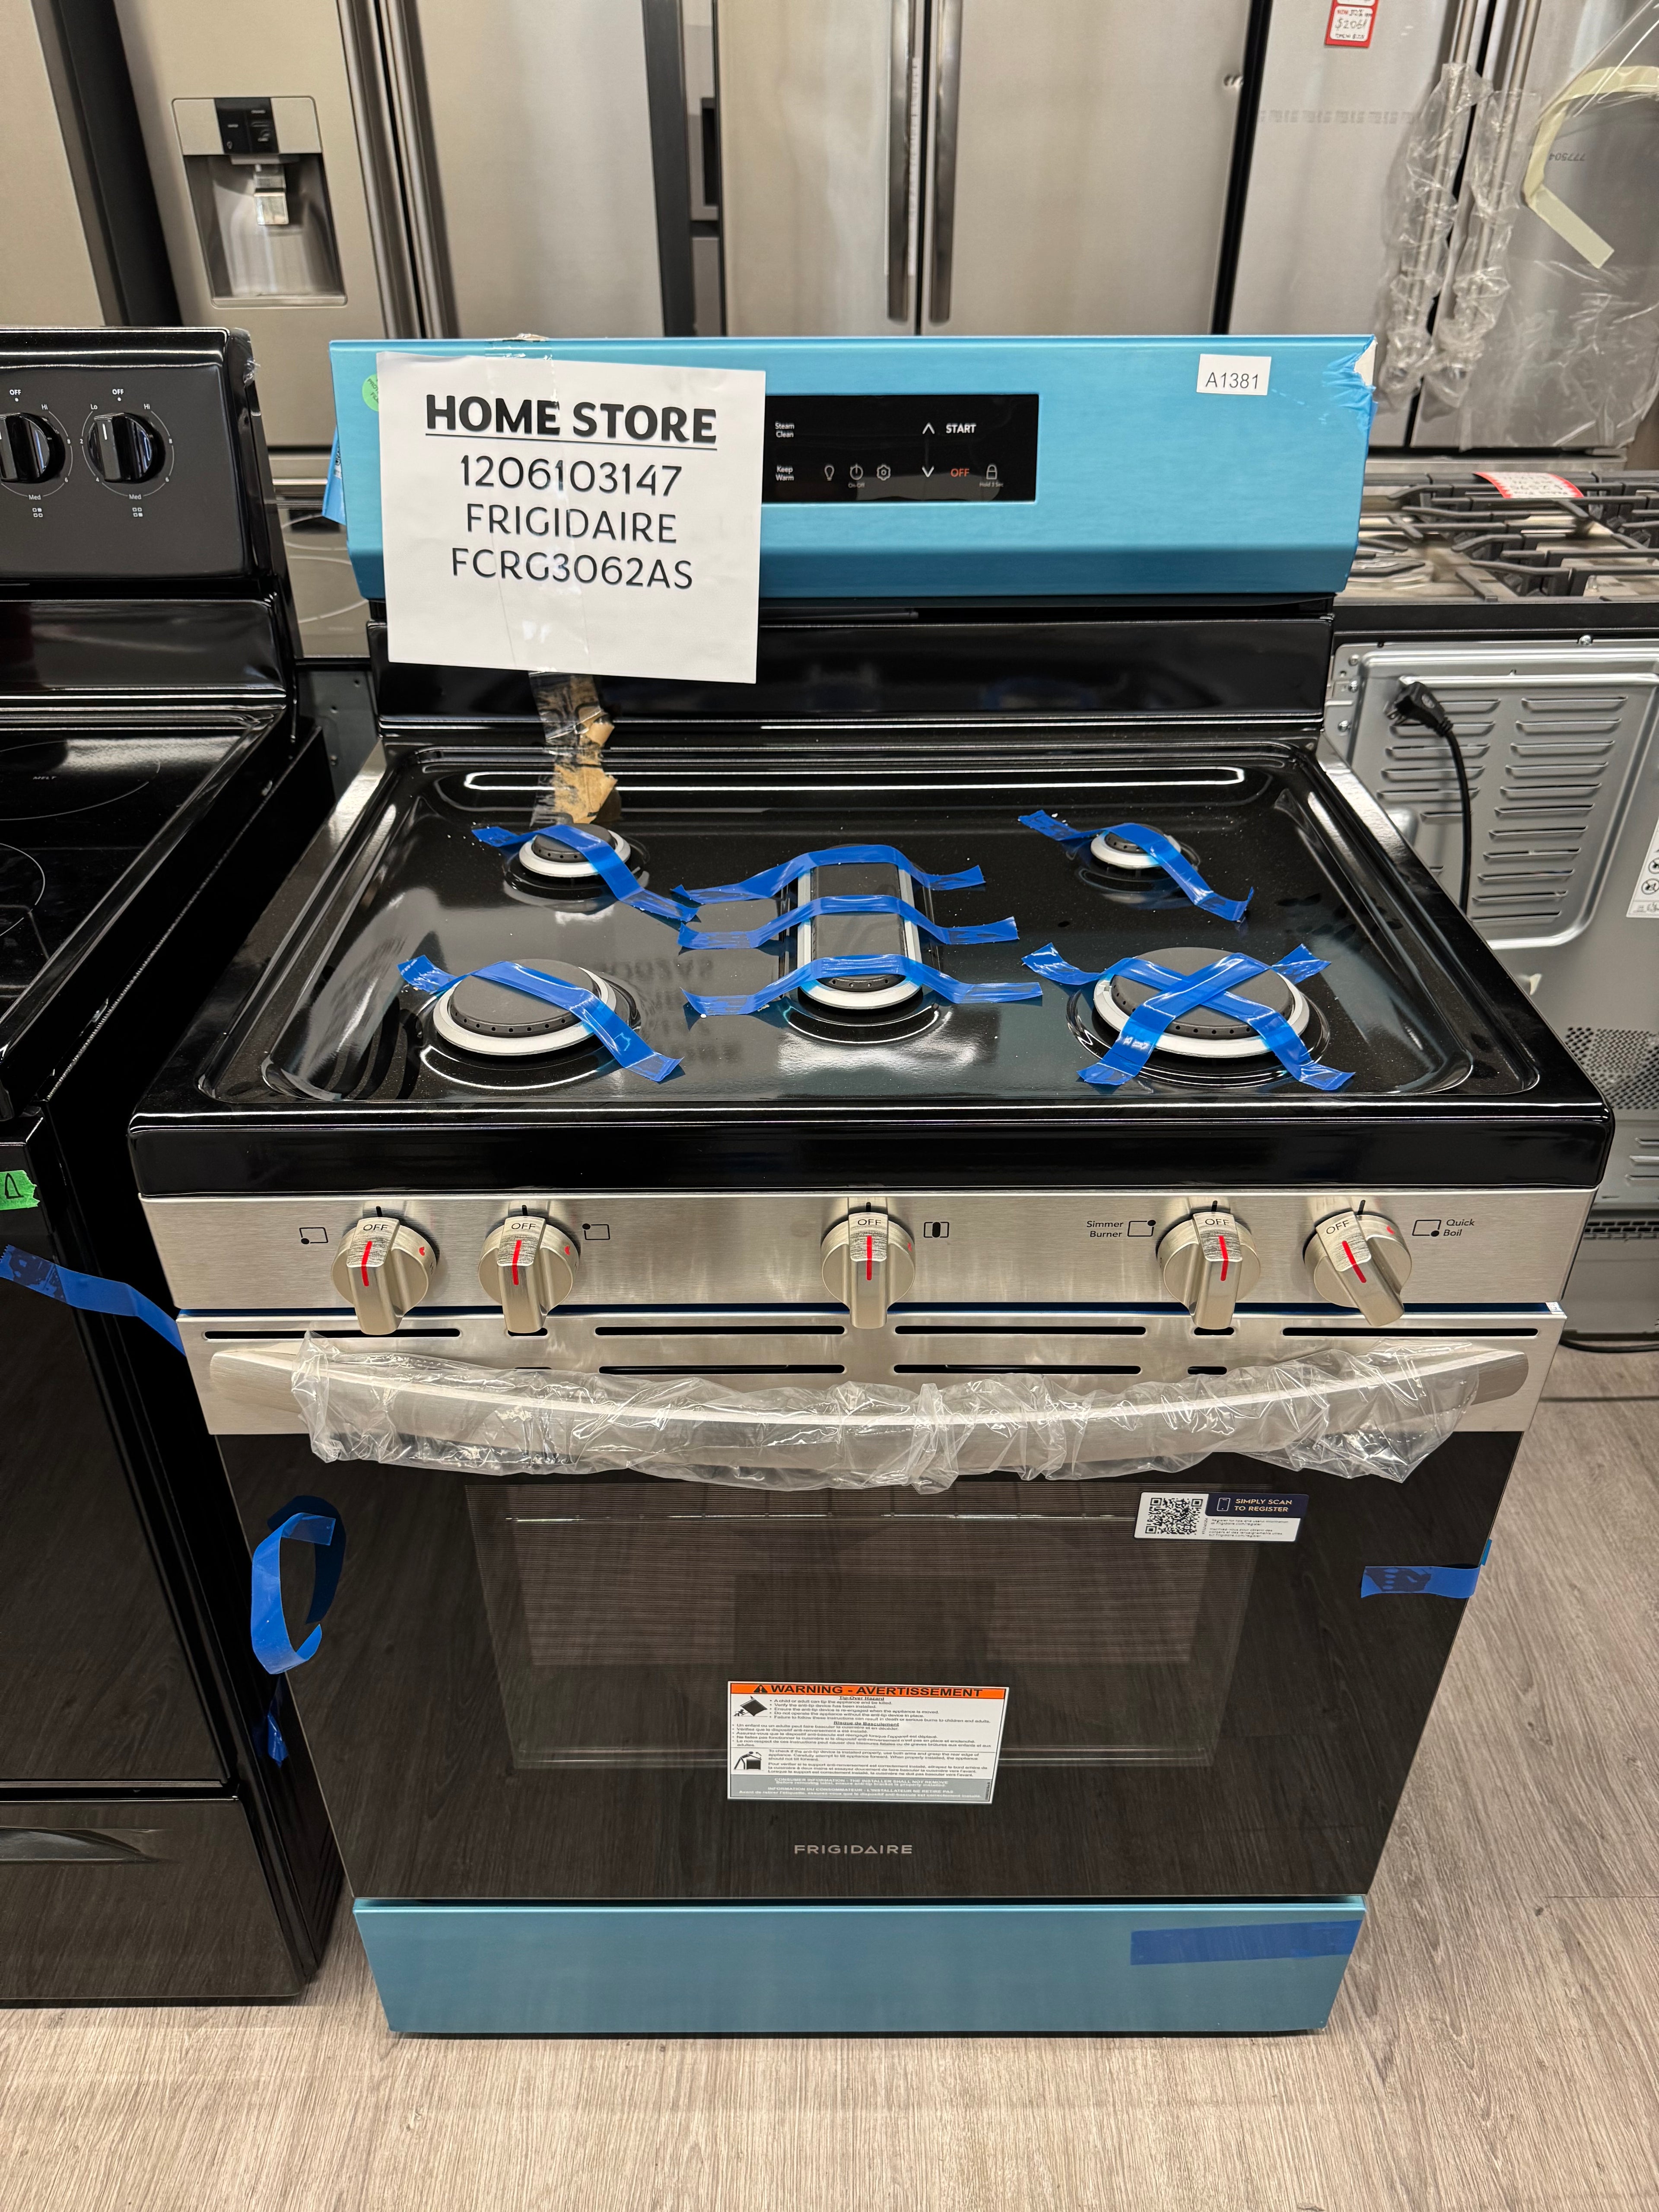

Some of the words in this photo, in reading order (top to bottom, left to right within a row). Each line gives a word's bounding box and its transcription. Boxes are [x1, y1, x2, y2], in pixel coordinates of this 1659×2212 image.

[1205, 372, 1258, 389] A1381
[426, 394, 561, 435] HOME
[573, 402, 716, 444] STORE
[946, 423, 976, 433] START
[777, 465, 793, 474] Keep
[950, 468, 969, 477] OFF
[461, 454, 682, 497] 1206103147
[467, 503, 677, 544] FRIGIDAIRE
[452, 547, 693, 590] FCRG3062AS
[1086, 1220, 1124, 1229] Simmer
[1205, 1218, 1230, 1227] OFF
[1446, 1218, 1475, 1227] Quick
[1326, 1220, 1350, 1236] OFF
[1090, 1230, 1122, 1238] Burner
[770, 1685, 843, 1694] WARNING
[856, 1686, 982, 1697] AVERTISSEMENT
[795, 1844, 912, 1854] FRIGIDAIRE
